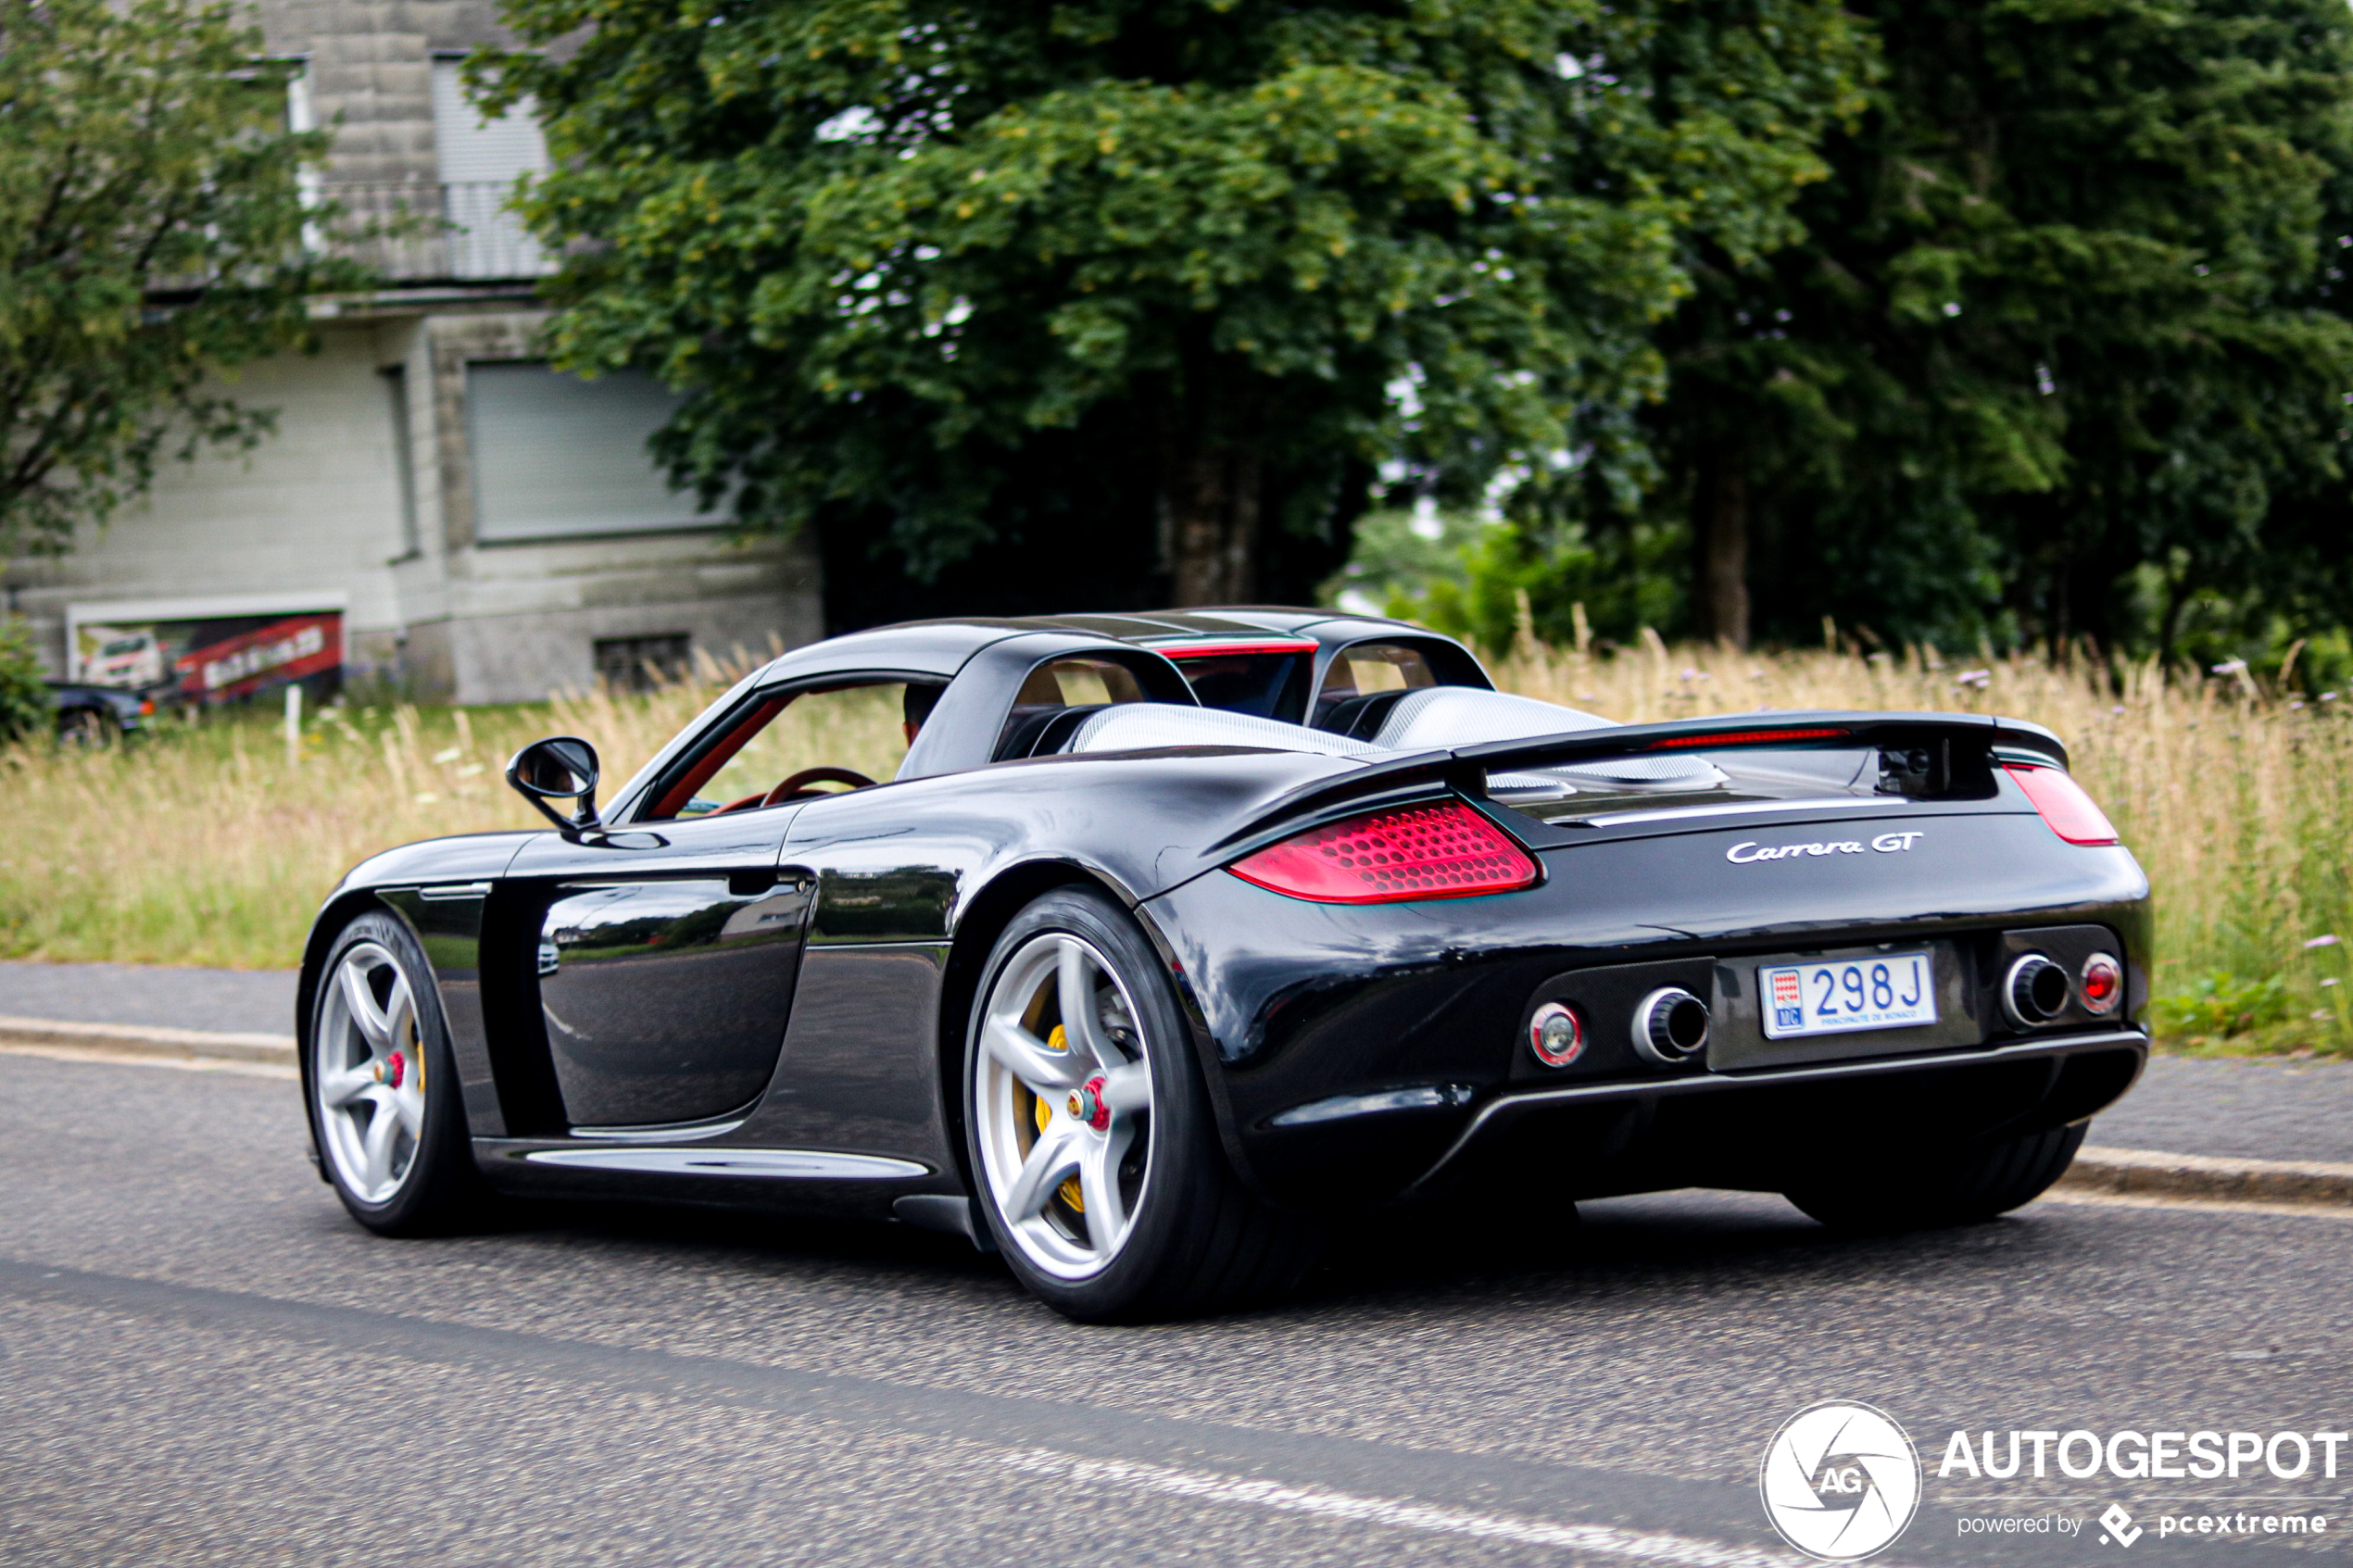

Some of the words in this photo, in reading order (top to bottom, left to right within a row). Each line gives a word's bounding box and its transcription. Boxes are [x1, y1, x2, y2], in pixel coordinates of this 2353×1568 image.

[1727, 842, 1865, 864] Carrera
[1871, 832, 1924, 853] GT
[1813, 960, 1920, 1016] 298J
[1780, 1010, 1799, 1026] MC
[1872, 1012, 1881, 1021] DE
[1884, 1010, 1918, 1021] MONACO
